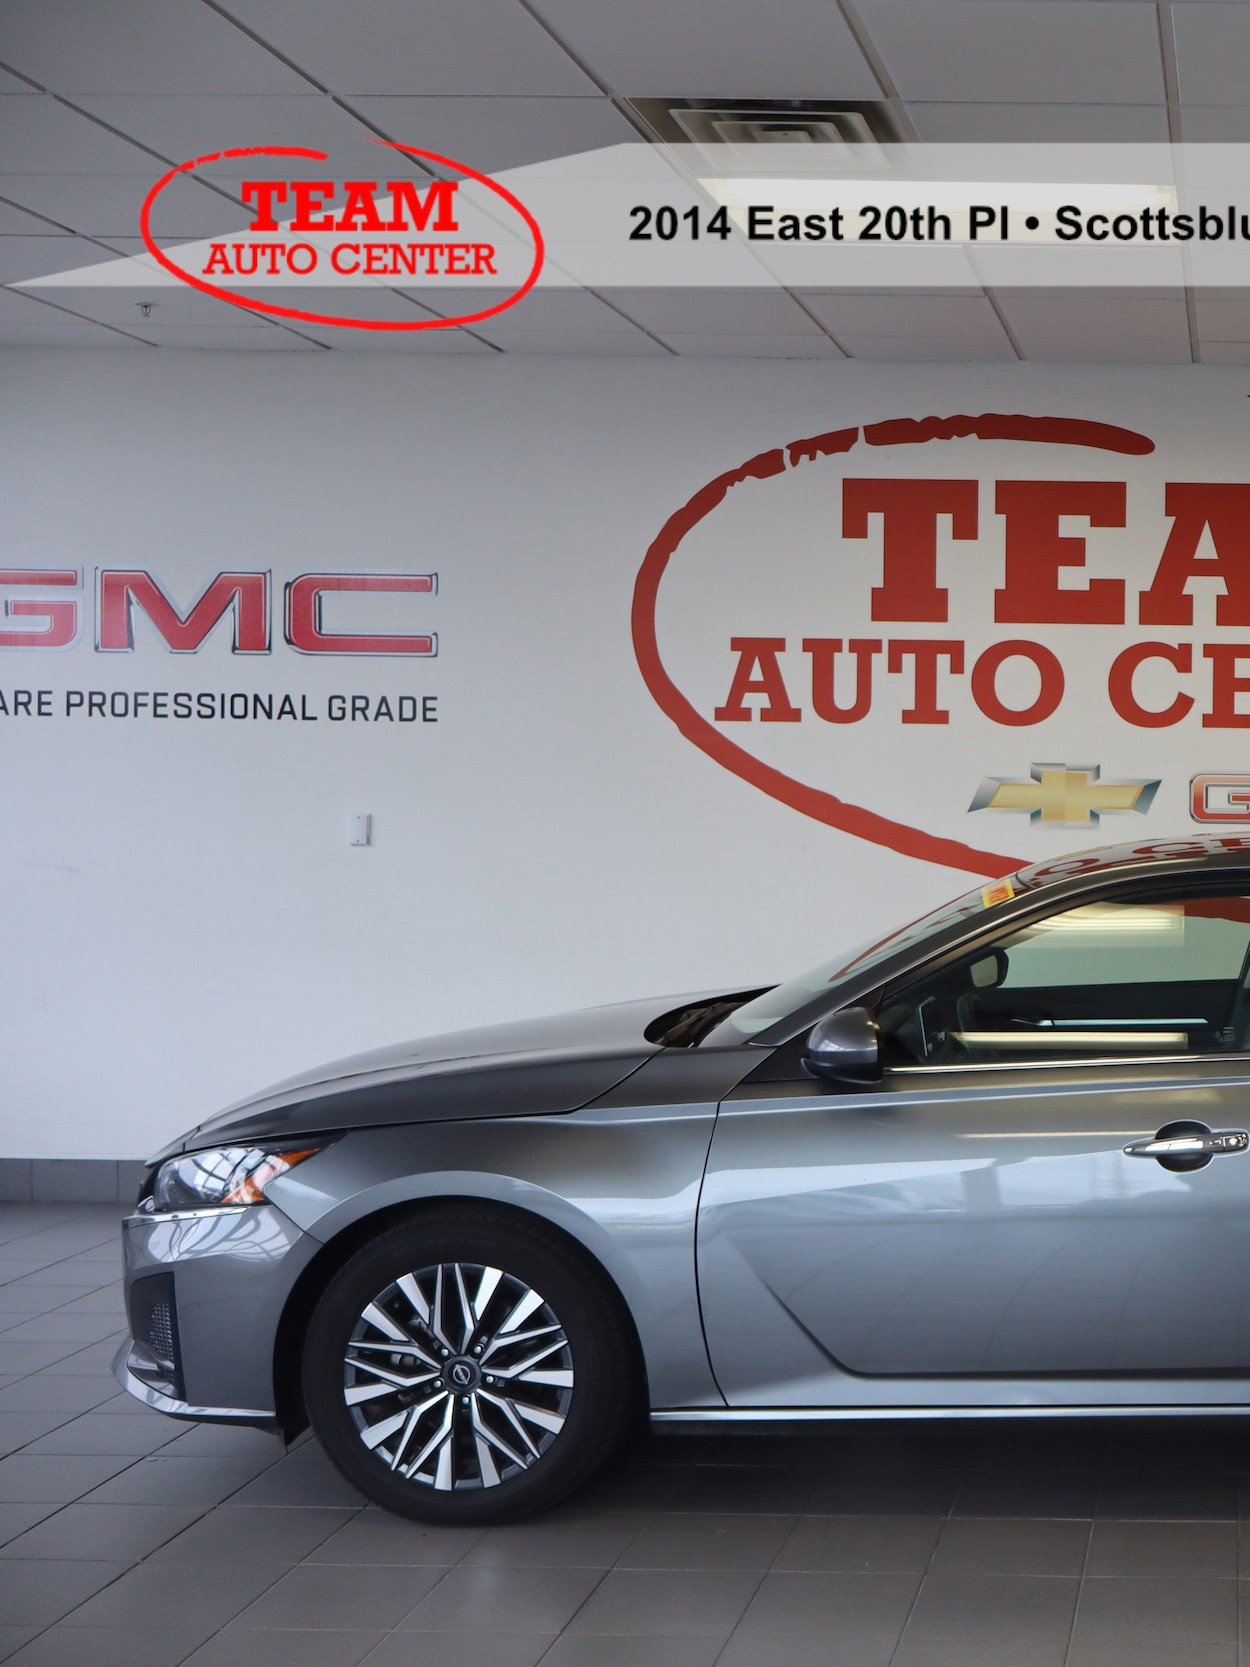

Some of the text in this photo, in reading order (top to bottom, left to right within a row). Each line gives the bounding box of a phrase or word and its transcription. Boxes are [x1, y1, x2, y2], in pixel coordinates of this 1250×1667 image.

[0, 567, 439, 657] GMC
[66, 691, 318, 721] PROFESSIONAL
[328, 695, 438, 723] GRADE
[714, 637, 1065, 727] AUTO
